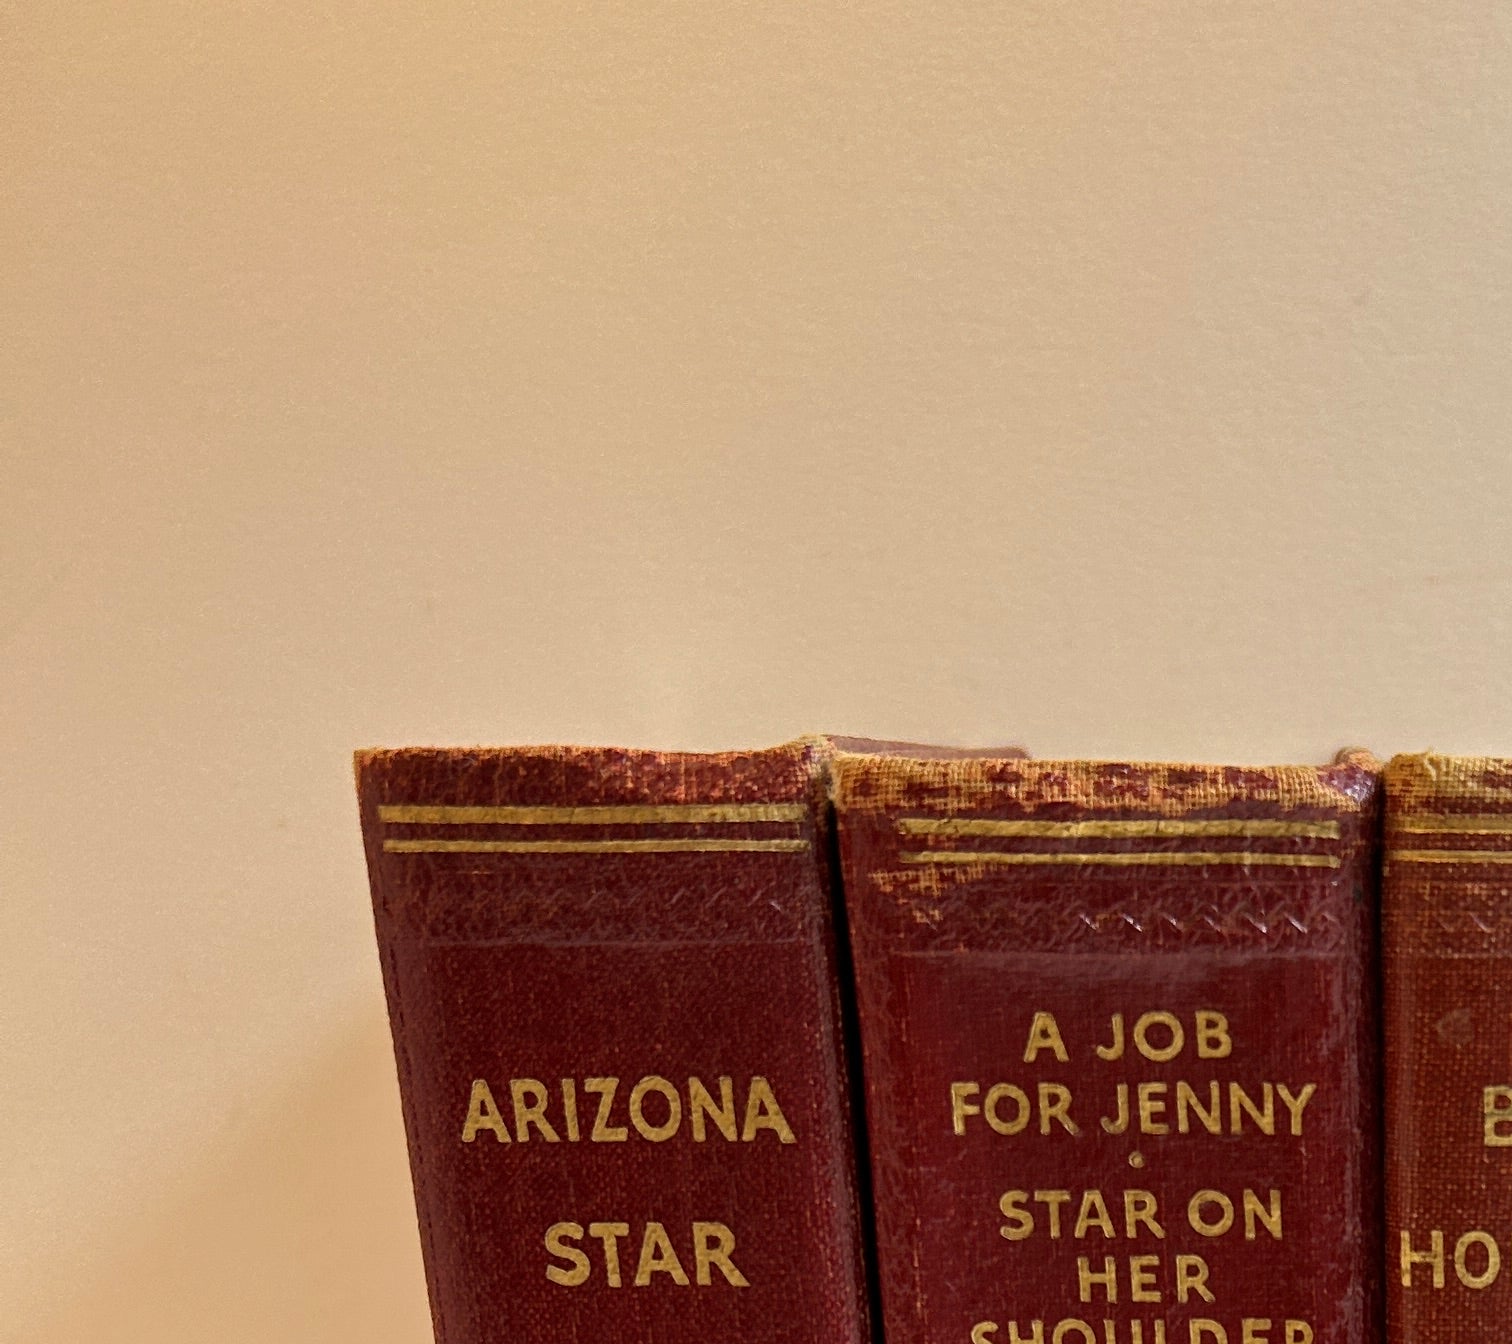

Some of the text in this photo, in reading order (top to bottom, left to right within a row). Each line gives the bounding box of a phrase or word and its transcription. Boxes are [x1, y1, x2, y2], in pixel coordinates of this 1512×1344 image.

[1023, 1011, 1232, 1063] A JOB
[460, 1075, 797, 1145] ARIZONA
[950, 1082, 1315, 1137] FOR JENNY
[998, 1189, 1283, 1242] STAR ON
[544, 1222, 751, 1288] STAR
[1078, 1255, 1214, 1304] HER
